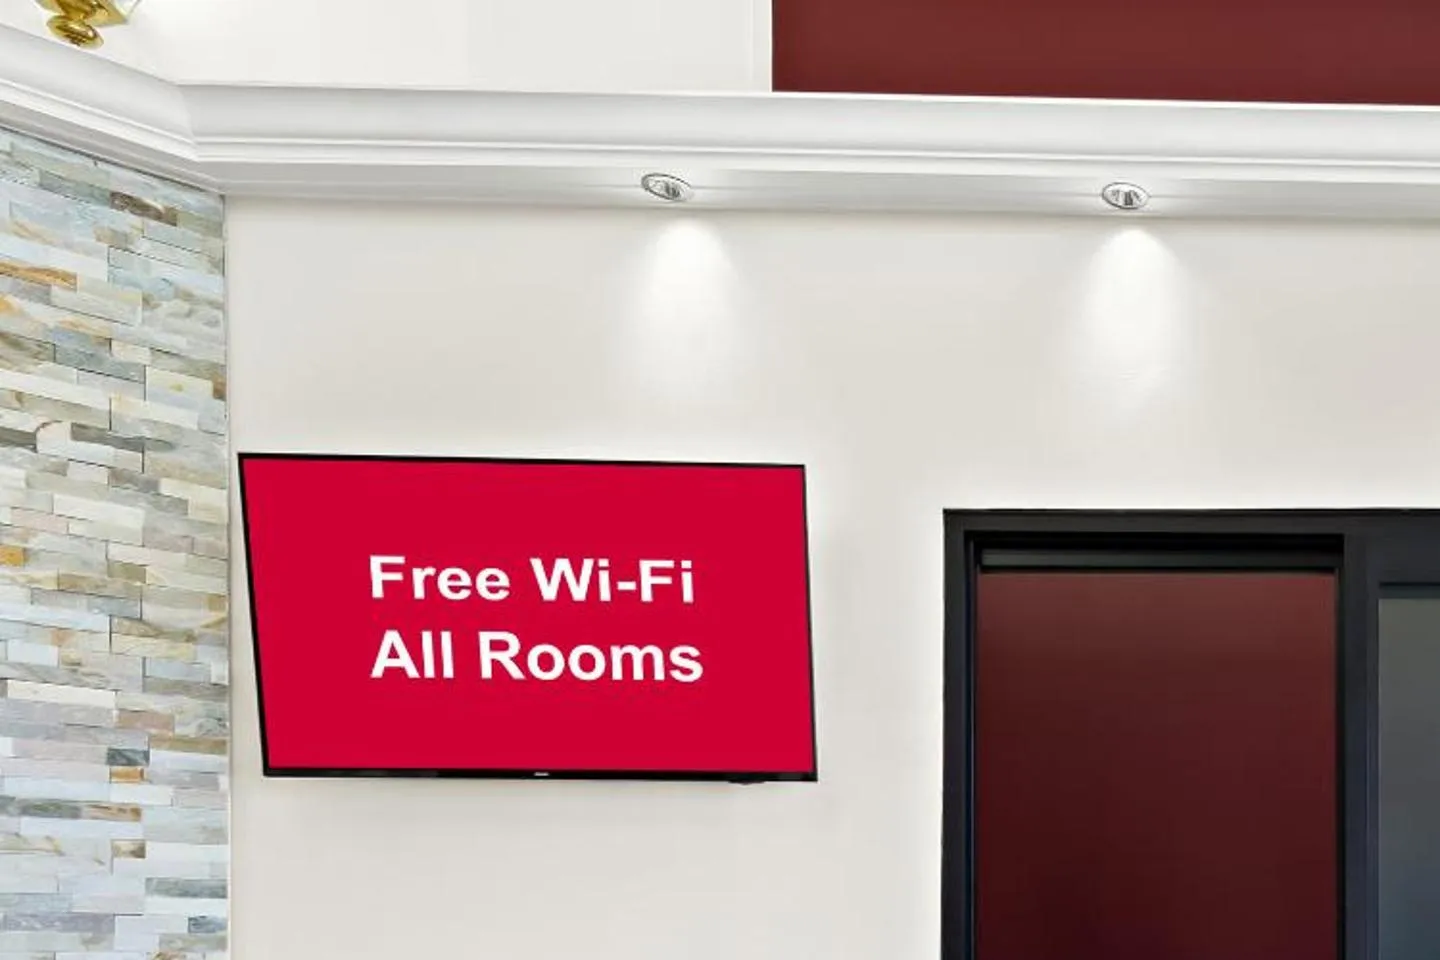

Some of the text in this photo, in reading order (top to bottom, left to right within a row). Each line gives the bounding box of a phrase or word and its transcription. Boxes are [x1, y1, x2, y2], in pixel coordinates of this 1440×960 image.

[368, 555, 695, 604] Free Wi-Fi
[370, 629, 705, 683] All Rooms
